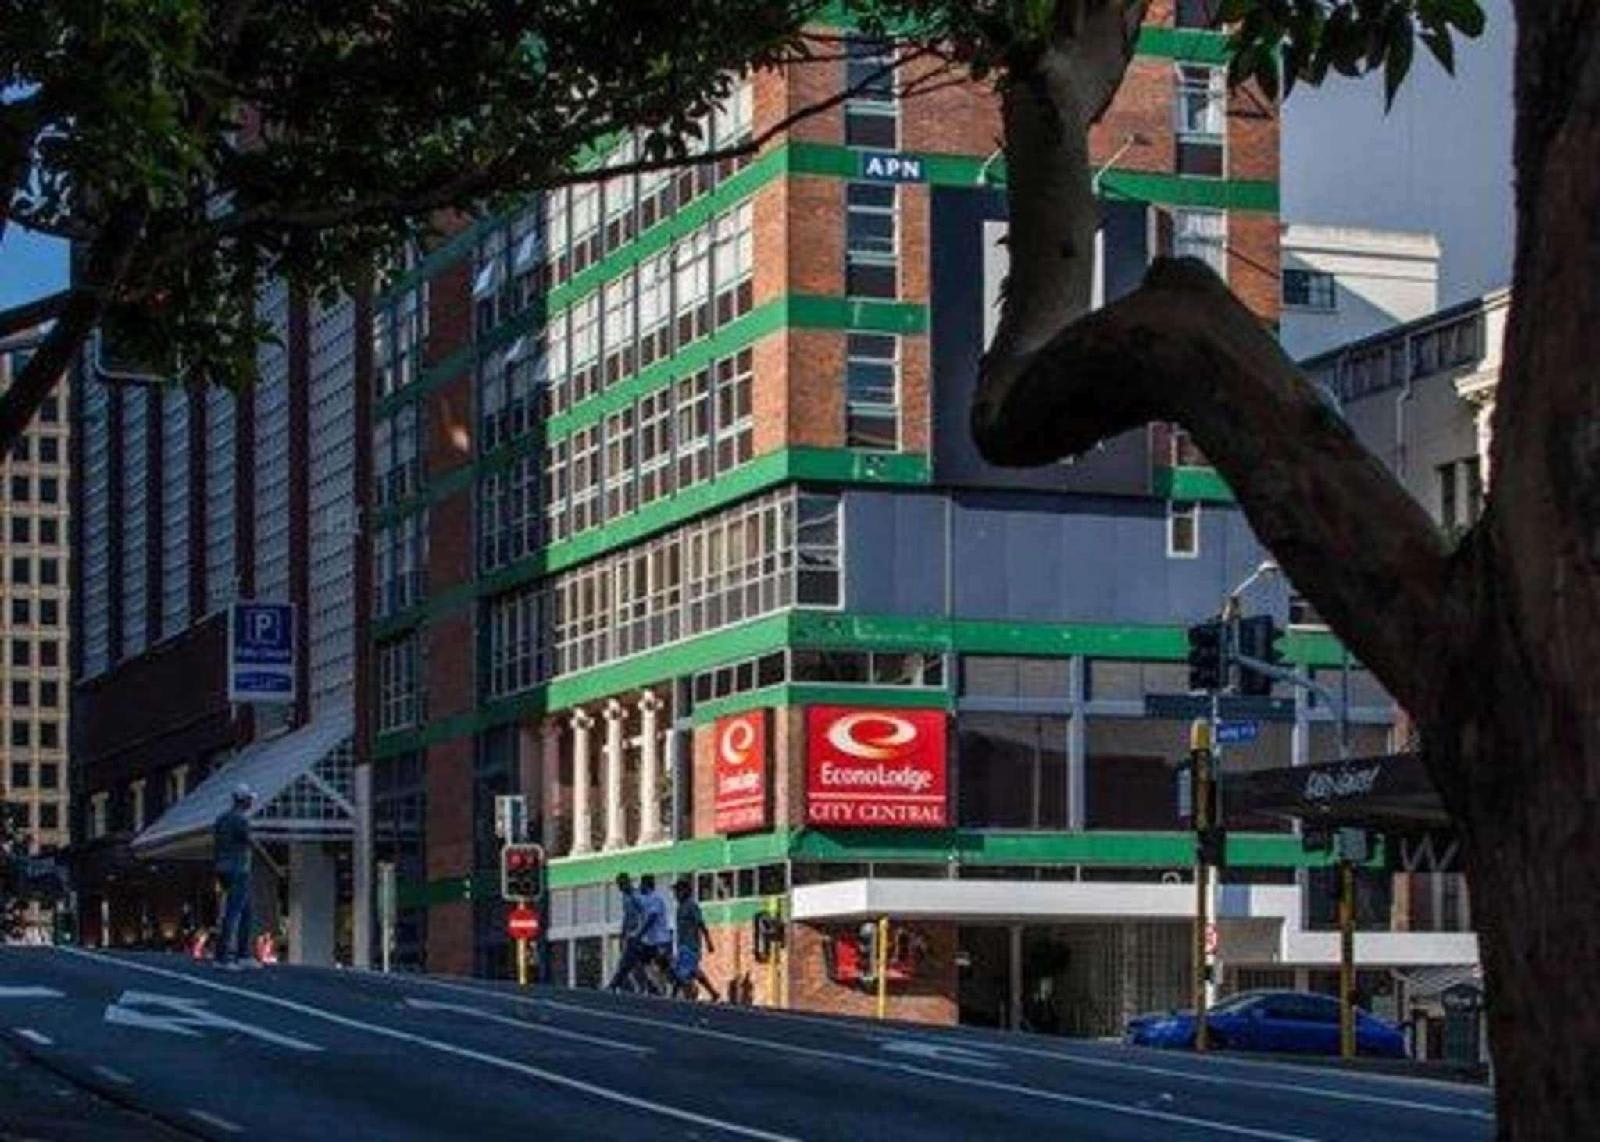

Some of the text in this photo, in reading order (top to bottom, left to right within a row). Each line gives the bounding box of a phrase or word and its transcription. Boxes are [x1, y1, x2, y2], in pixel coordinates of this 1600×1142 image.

[865, 157, 920, 178] APN
[255, 613, 271, 639] P
[820, 761, 934, 792] EconoLodge
[808, 802, 942, 822] CITY CENTRAL
